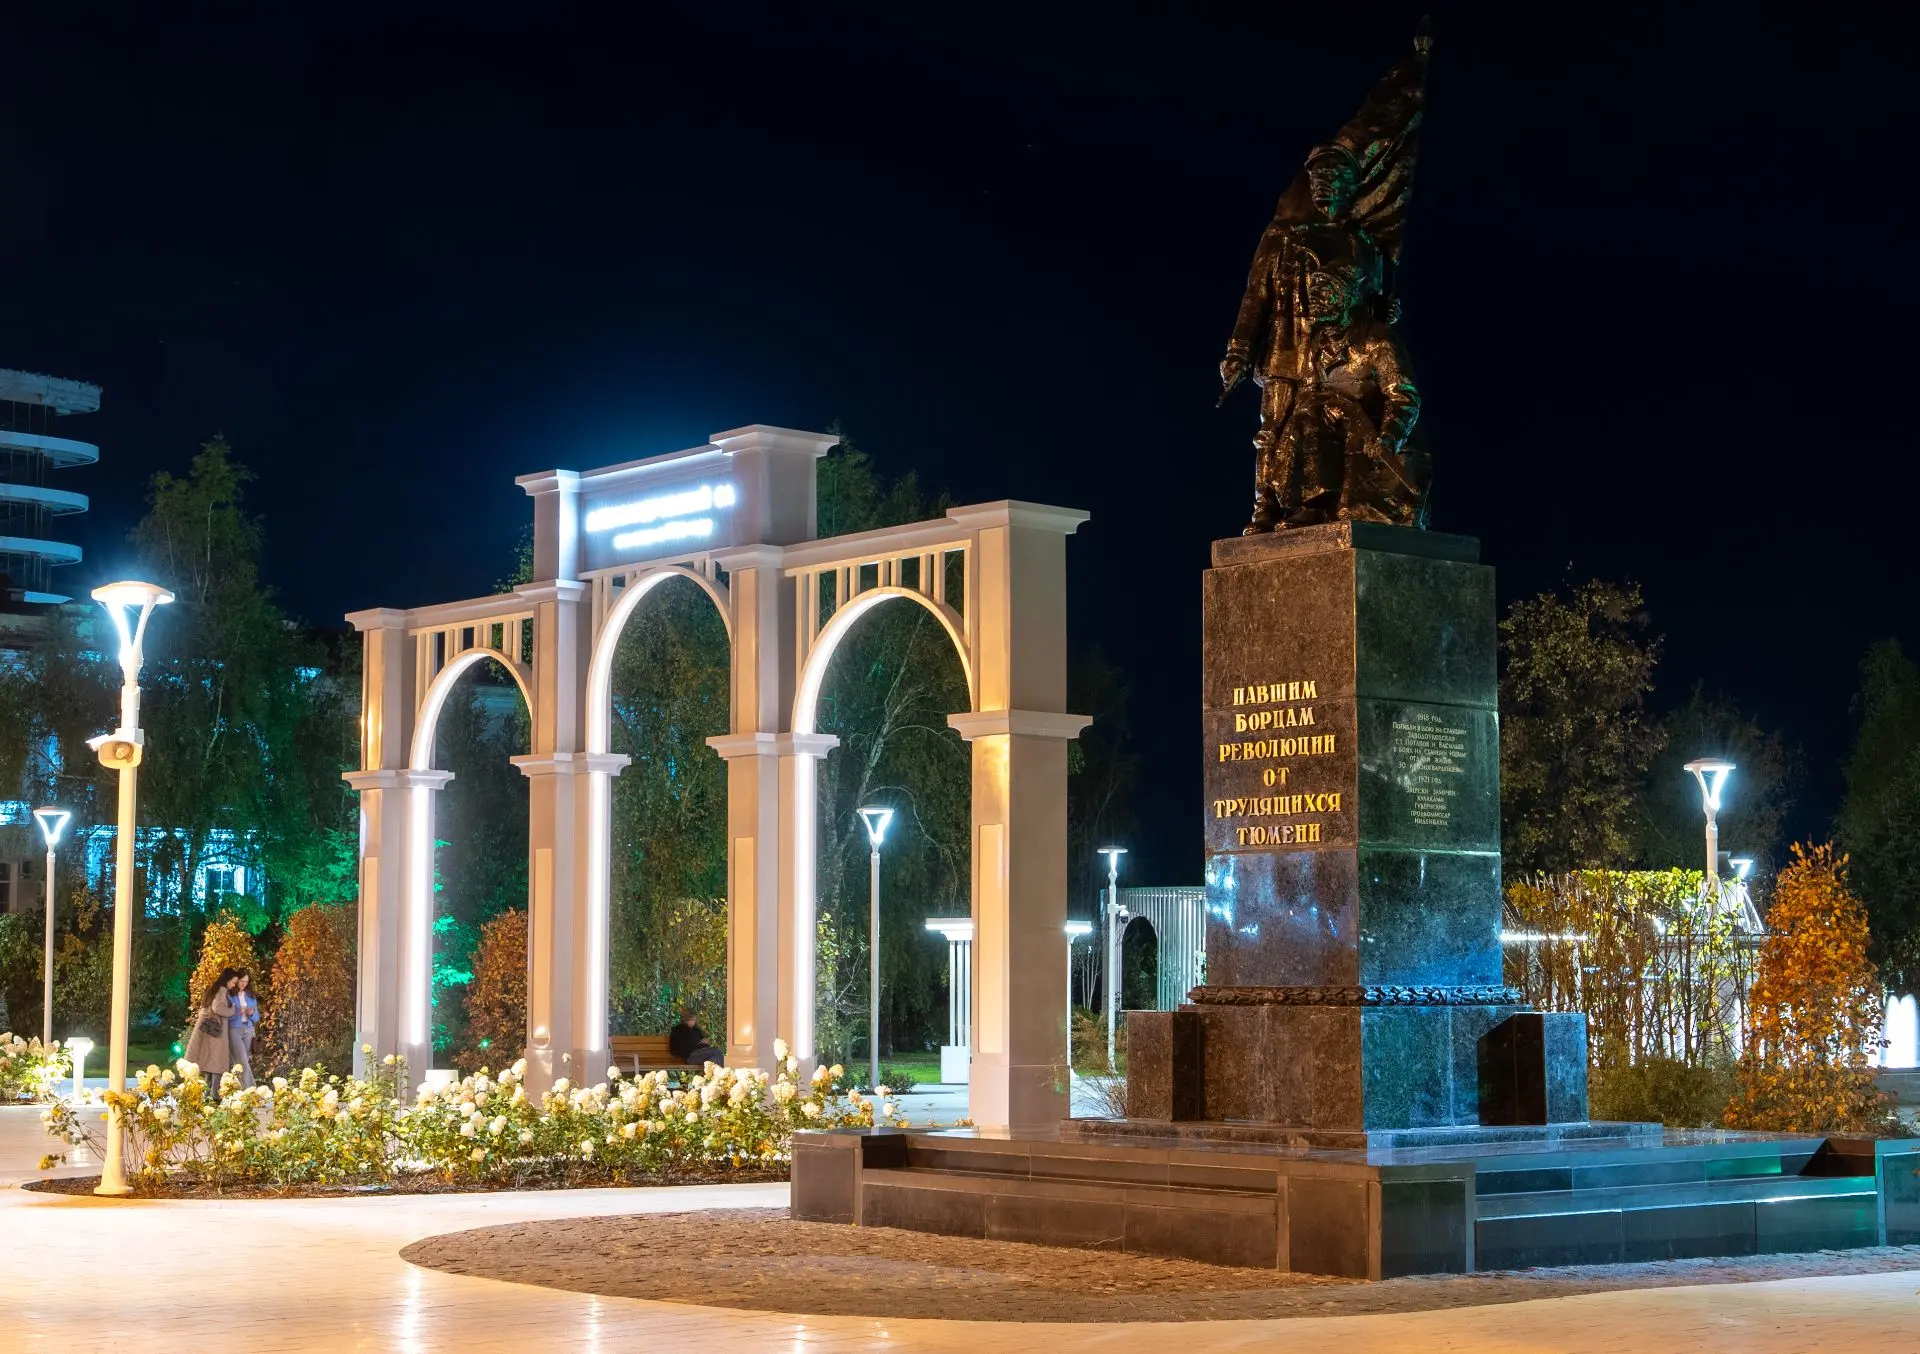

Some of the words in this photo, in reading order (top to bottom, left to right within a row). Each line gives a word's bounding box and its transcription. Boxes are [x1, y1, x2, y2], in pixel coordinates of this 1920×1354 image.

[1233, 680, 1317, 706] ПАВШИМ
[1235, 707, 1316, 733] БОРЦАМ
[1219, 734, 1336, 763] РЕВОЛЮЦИИ
[1263, 767, 1290, 787] ОТ
[1418, 775, 1430, 783] 1921
[1214, 793, 1342, 819] ТРУДЯЩИХСЯ
[1236, 823, 1321, 846] ТЮМЕНИ
